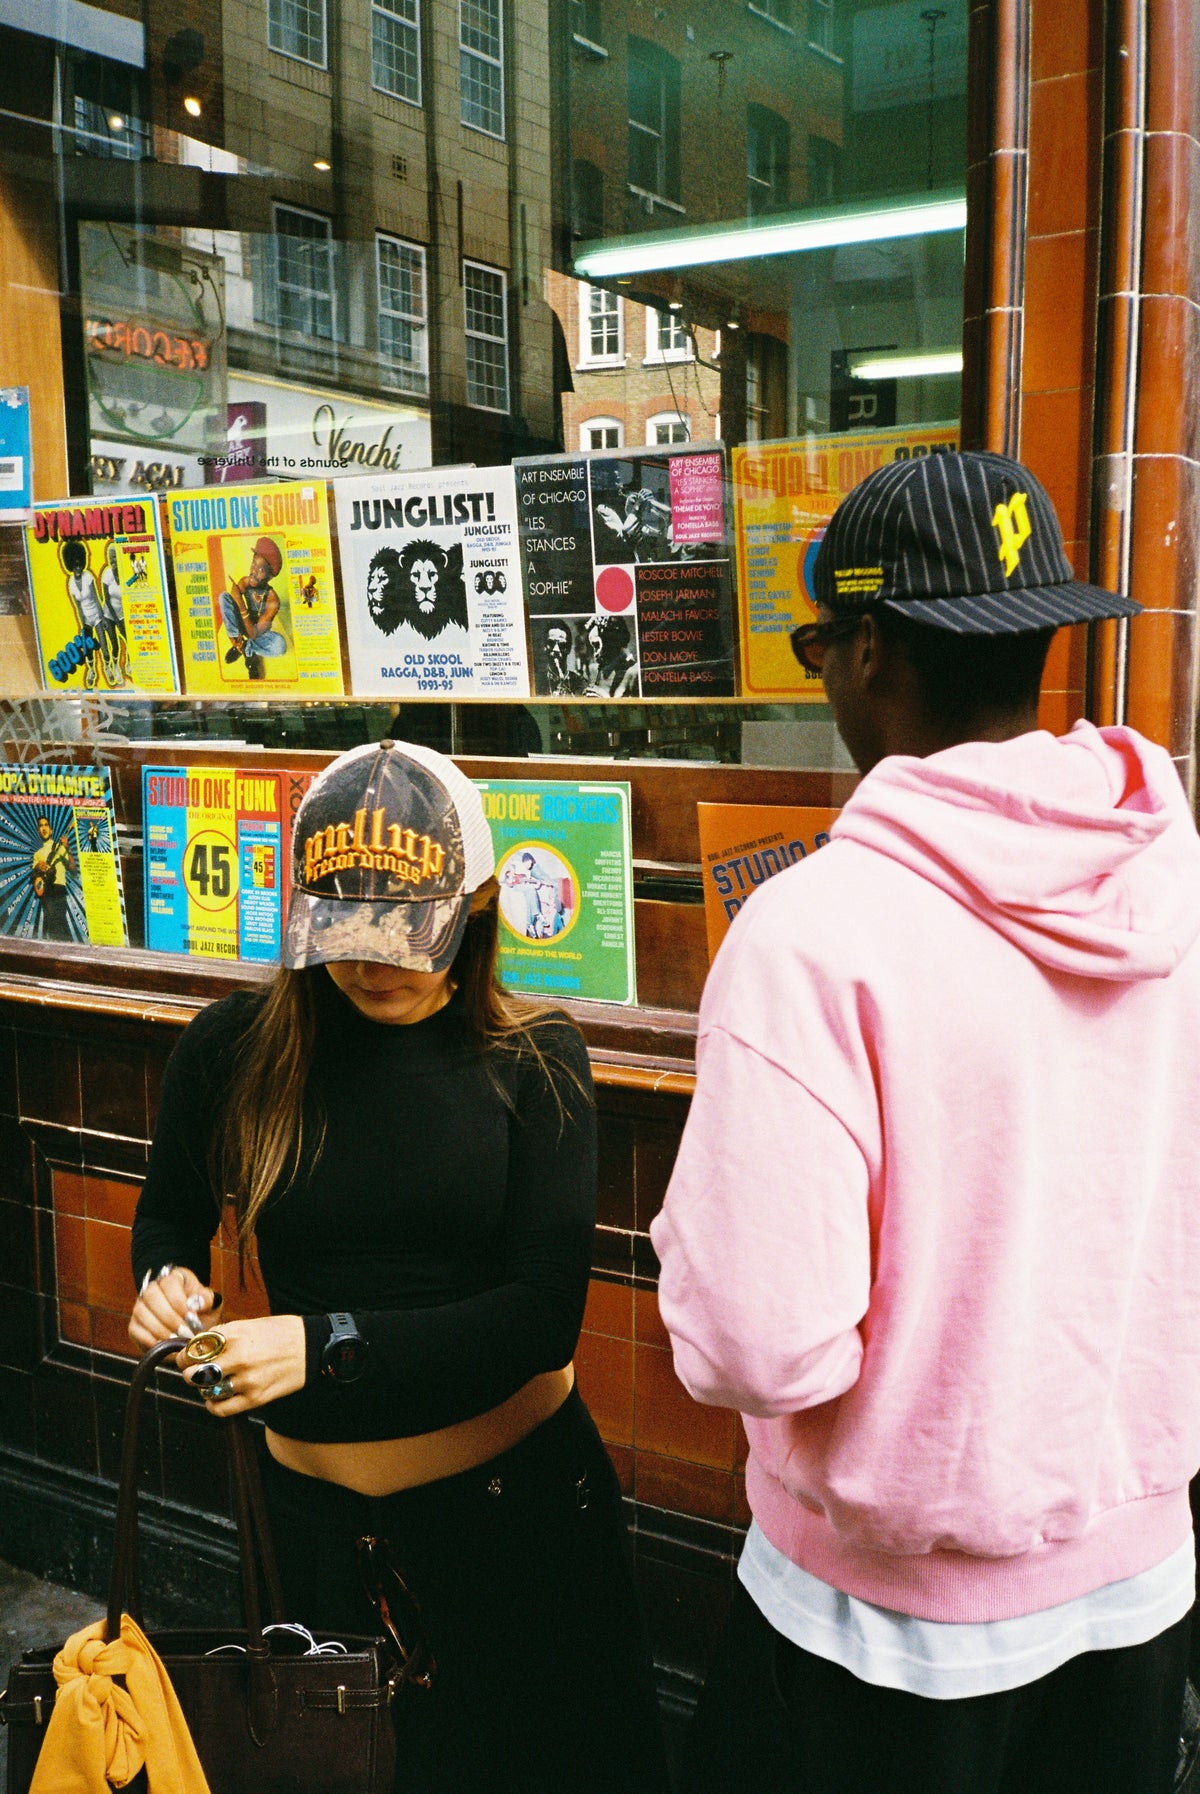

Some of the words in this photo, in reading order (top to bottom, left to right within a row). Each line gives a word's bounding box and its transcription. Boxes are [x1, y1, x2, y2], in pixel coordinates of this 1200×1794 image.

[313, 404, 403, 471] Venchi
[671, 458, 684, 468] ART
[685, 456, 720, 466] ENSEMBLE
[521, 470, 537, 483] ART
[539, 467, 585, 481] ENSEMBLE
[672, 468, 682, 476] OF
[684, 465, 720, 476] CHICAGO
[743, 454, 829, 500] STUDIO
[522, 493, 536, 505] OF
[538, 490, 586, 504] CHICAGO
[172, 497, 227, 532] STUDIO
[229, 495, 260, 529] ONE
[262, 492, 320, 527] SOUND
[350, 492, 496, 530] JUNGLIST!
[34, 504, 146, 543] DYNAMITE!
[464, 524, 512, 537] JUNGLIST!
[526, 536, 576, 552] STANCES
[470, 559, 509, 569] JUNGLIST!
[528, 561, 536, 574] A
[638, 568, 678, 580] ROSCOE
[680, 566, 724, 579] MITCHELL
[639, 591, 673, 603] JOSEPH
[675, 590, 716, 602] JARMAN
[641, 611, 683, 622] MALACHI
[685, 608, 719, 621] FAVORS
[641, 630, 669, 643] LESTER
[671, 629, 703, 642] BOWIE
[48, 629, 98, 683] 600%
[404, 655, 425, 665] OLD
[428, 654, 462, 665] SKOOL
[643, 651, 667, 663] DON
[669, 650, 698, 662] MOYE
[381, 667, 422, 680] RAGGA,
[424, 667, 448, 680] D&B,
[643, 671, 688, 682] FONTELLA
[689, 671, 713, 682] BASS
[417, 680, 453, 690] 1993-95
[27, 773, 106, 797] DYNAMITE!
[148, 776, 200, 808] STUDIO
[203, 778, 230, 809] ONE
[237, 779, 277, 813] FUNK
[508, 793, 541, 821] ONE
[543, 795, 619, 824] ROCKERS
[190, 844, 231, 898] 45
[254, 861, 264, 873] 45
[312, 845, 422, 887] recordings
[711, 839, 808, 896] STUDIO
[200, 941, 214, 953] JAZZ
[517, 947, 544, 957] AROUND
[544, 950, 558, 958] THE
[558, 951, 583, 960] WORLD
